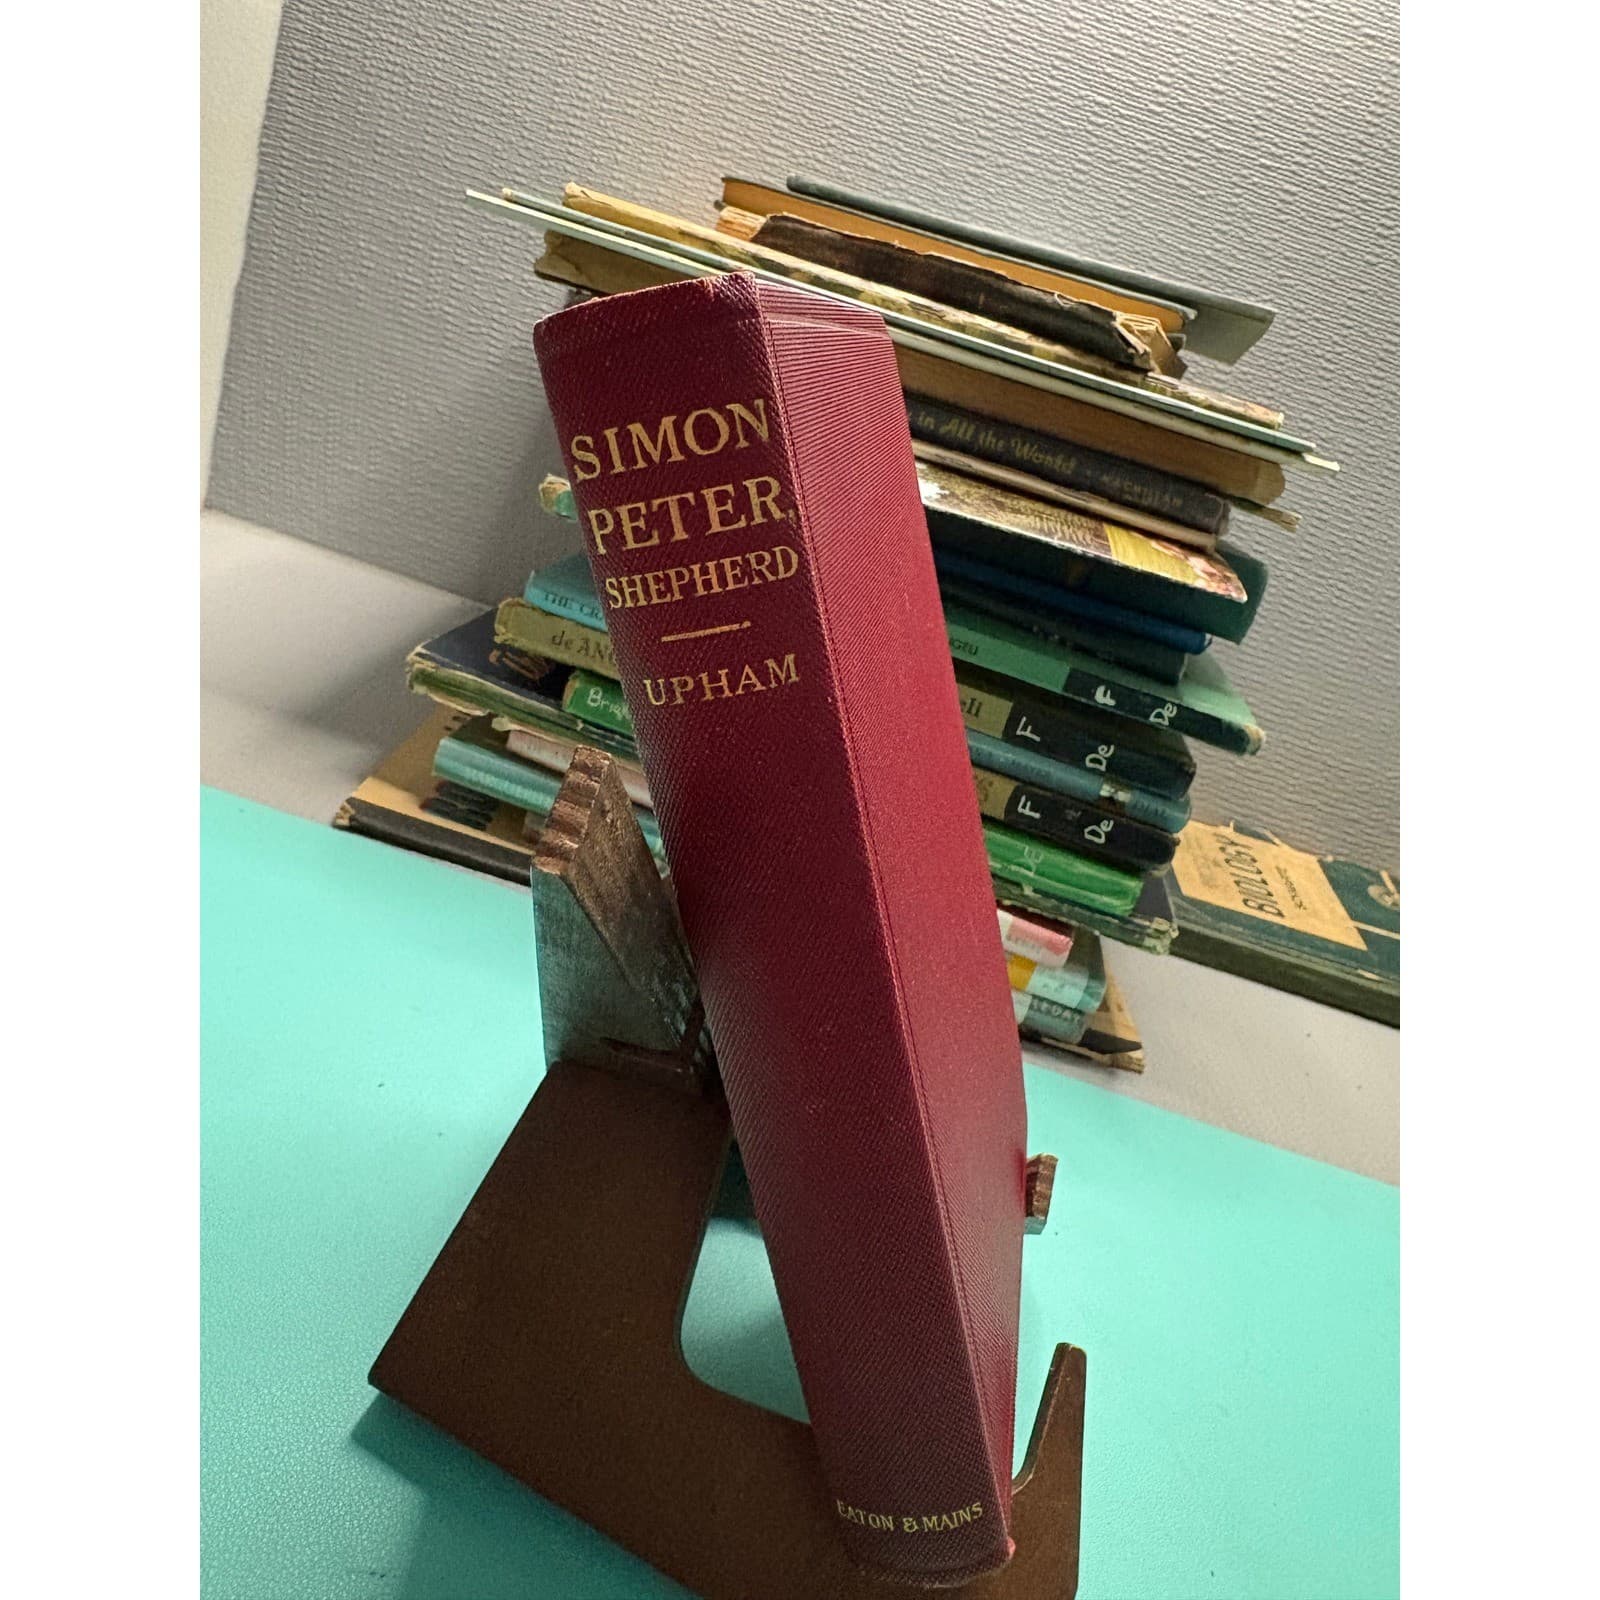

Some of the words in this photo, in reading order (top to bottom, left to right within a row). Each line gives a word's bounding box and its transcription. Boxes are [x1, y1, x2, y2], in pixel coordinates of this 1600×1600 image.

[570, 399, 769, 482] SIMON
[605, 546, 799, 609] SHEPHERD
[552, 630, 573, 650] de
[644, 654, 799, 707] UPHAM
[1094, 684, 1116, 706] F
[1148, 702, 1178, 726] De
[1016, 716, 1041, 742] F
[1085, 744, 1115, 772] De
[1017, 795, 1041, 819] F
[1083, 818, 1115, 845] De
[1213, 833, 1285, 918] BIOLOGY
[836, 1499, 895, 1532] EATON
[902, 1517, 919, 1533] &
[922, 1502, 984, 1532] MAINS
